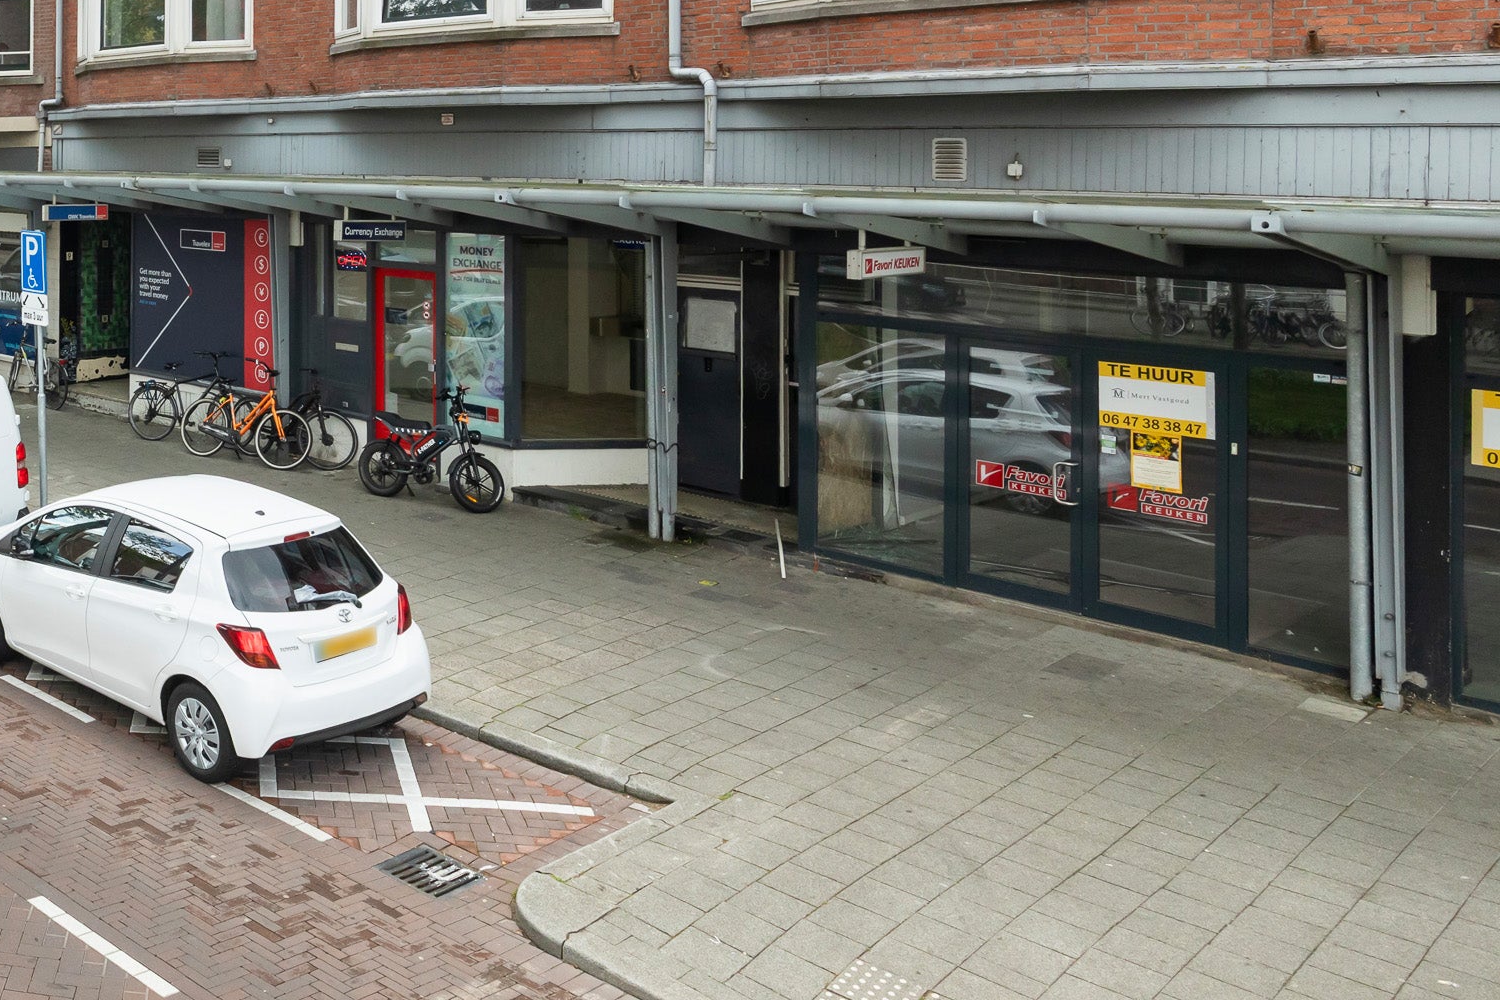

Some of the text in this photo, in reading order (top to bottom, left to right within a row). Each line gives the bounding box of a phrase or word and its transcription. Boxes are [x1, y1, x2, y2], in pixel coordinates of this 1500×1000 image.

[344, 227, 403, 238] Currency Exchange
[25, 235, 39, 266] P
[459, 245, 494, 257] MONEY
[337, 255, 367, 267] OPEN
[452, 257, 502, 270] EXCHANGE
[873, 256, 920, 272] Favori KEUKEN
[139, 267, 148, 275] Get
[161, 270, 172, 278] than
[139, 283, 161, 293] with your
[148, 277, 170, 285] expected
[139, 290, 169, 301] travel money
[1107, 363, 1195, 385] TE HUUR
[1102, 413, 1202, 435] 06 47 38 38 47
[1005, 465, 1066, 488] Favori
[1011, 482, 1063, 498] KEUKEN
[1139, 488, 1209, 511] Favori
[1145, 504, 1204, 522] KEUKEN
